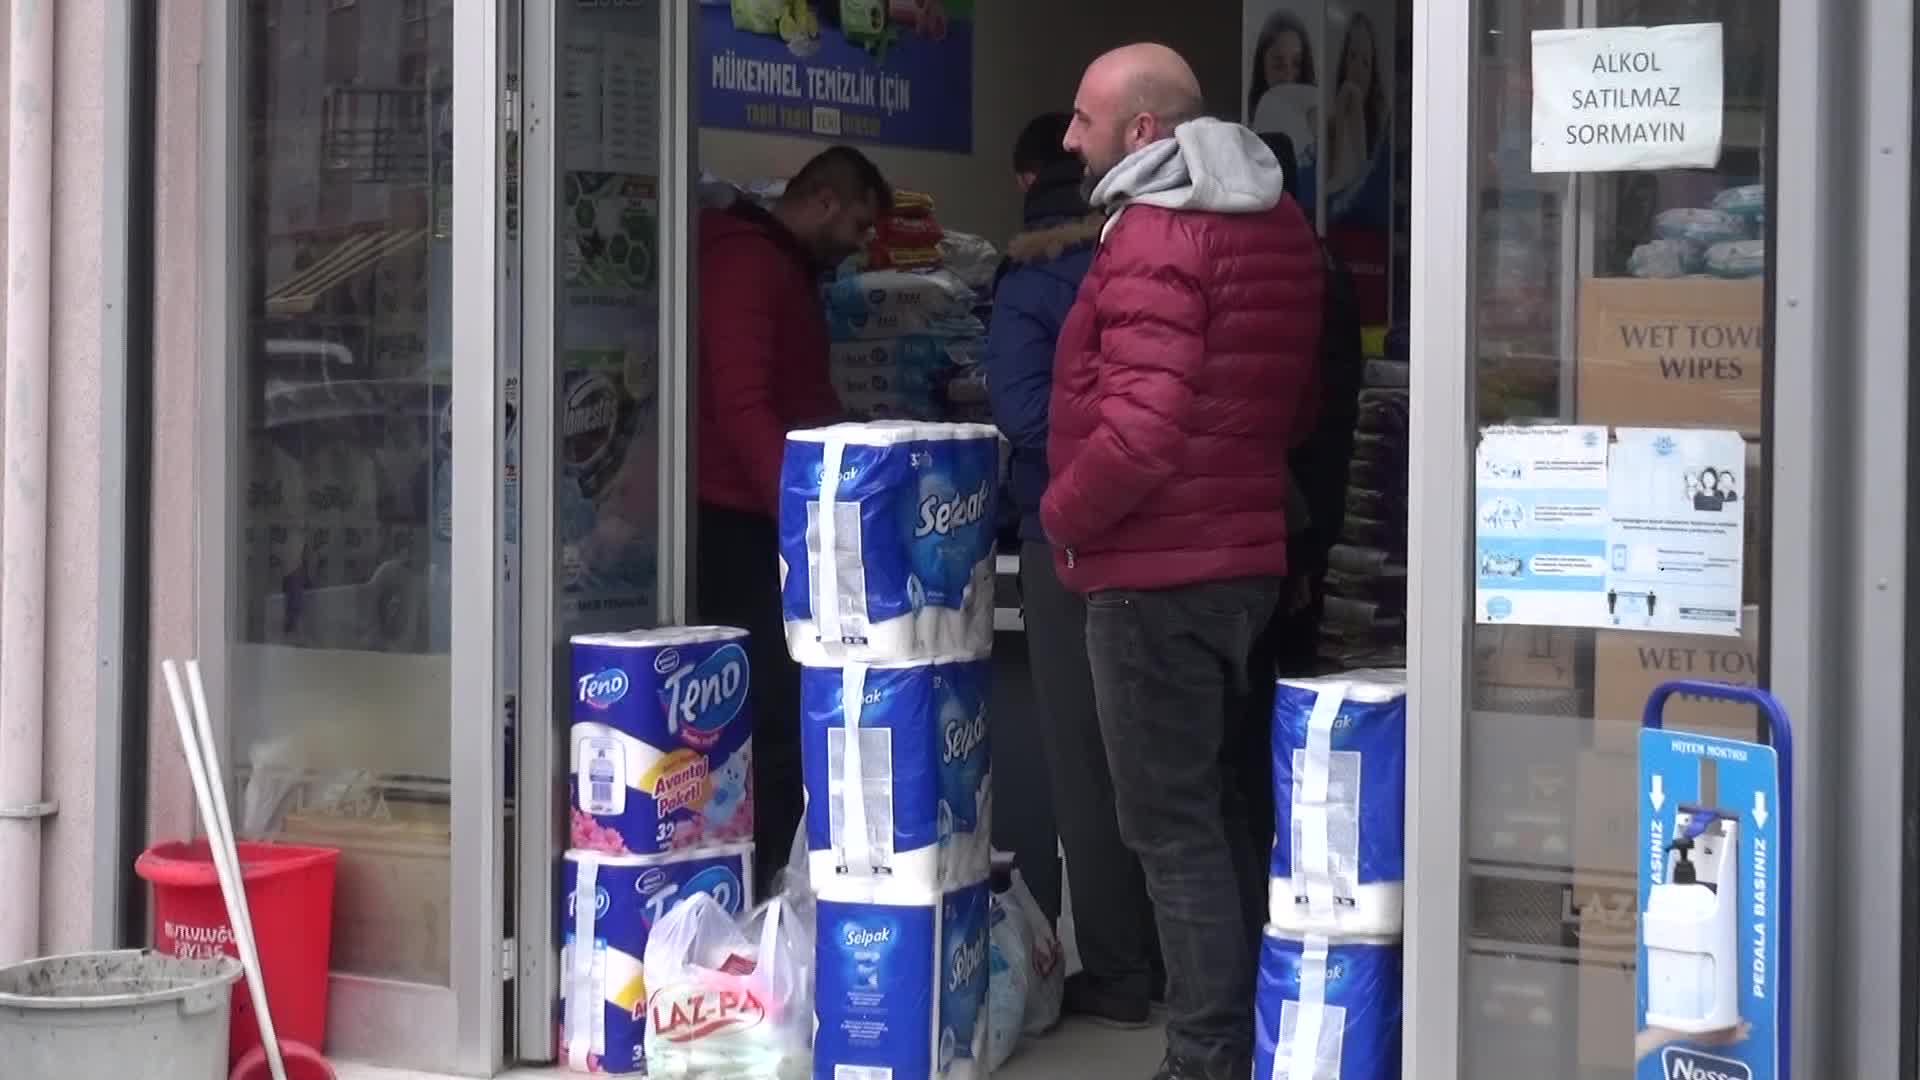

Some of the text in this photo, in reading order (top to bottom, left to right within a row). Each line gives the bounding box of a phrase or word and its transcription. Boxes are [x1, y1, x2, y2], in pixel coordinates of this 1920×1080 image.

[1592, 51, 1662, 73] ALKOL
[712, 52, 911, 116] MÜKEMMEL TEMİZLİK İÇİN
[1572, 87, 1681, 109] SATILMAZ
[1566, 122, 1686, 145] SORMAYIN
[1619, 325, 1679, 349] WET
[1660, 356, 1743, 380] WIPES
[1638, 647, 1696, 671] WET
[578, 673, 623, 702] Teno
[664, 661, 741, 735] Teno
[653, 755, 709, 799] Avantaj
[656, 822, 675, 842] 32
[1651, 819, 1663, 885] ASINIZ
[1753, 837, 1767, 999] PEDALA BASINIZ
[846, 927, 890, 948] Selpak
